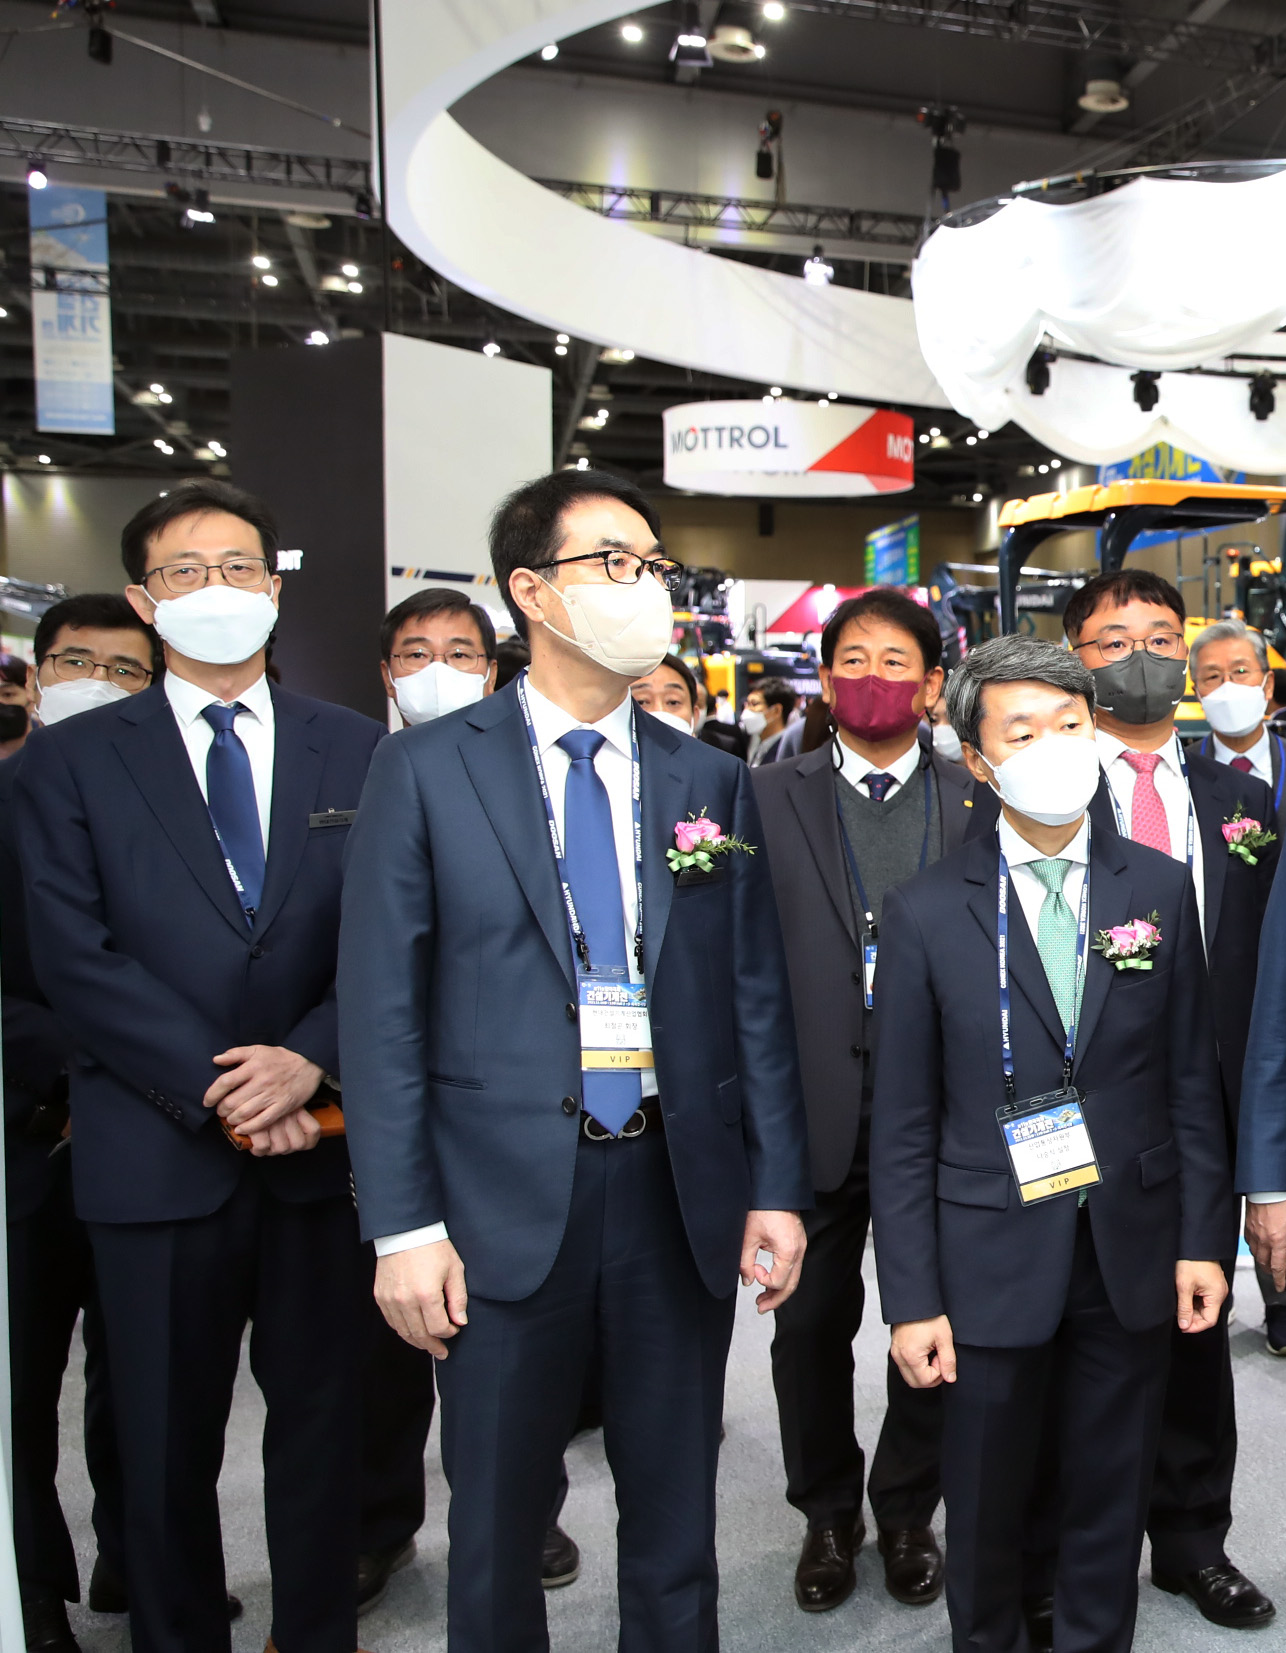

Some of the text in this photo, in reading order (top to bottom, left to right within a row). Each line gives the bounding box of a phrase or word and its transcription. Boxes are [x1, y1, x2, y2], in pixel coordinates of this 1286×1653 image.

[671, 425, 788, 454] MOTTROL
[887, 433, 914, 463] MO
[520, 694, 532, 726] HYUNDAI
[548, 819, 562, 859] DOOSAN
[1118, 812, 1128, 839] HYUNDA
[225, 858, 244, 892] DOOSAN
[999, 874, 1007, 915] DOOSAN
[586, 990, 629, 1003] 건설기계전
[609, 1055, 631, 1063] VIP
[1011, 1119, 1055, 1140] 건설기계전
[1049, 1177, 1070, 1189] VIP
